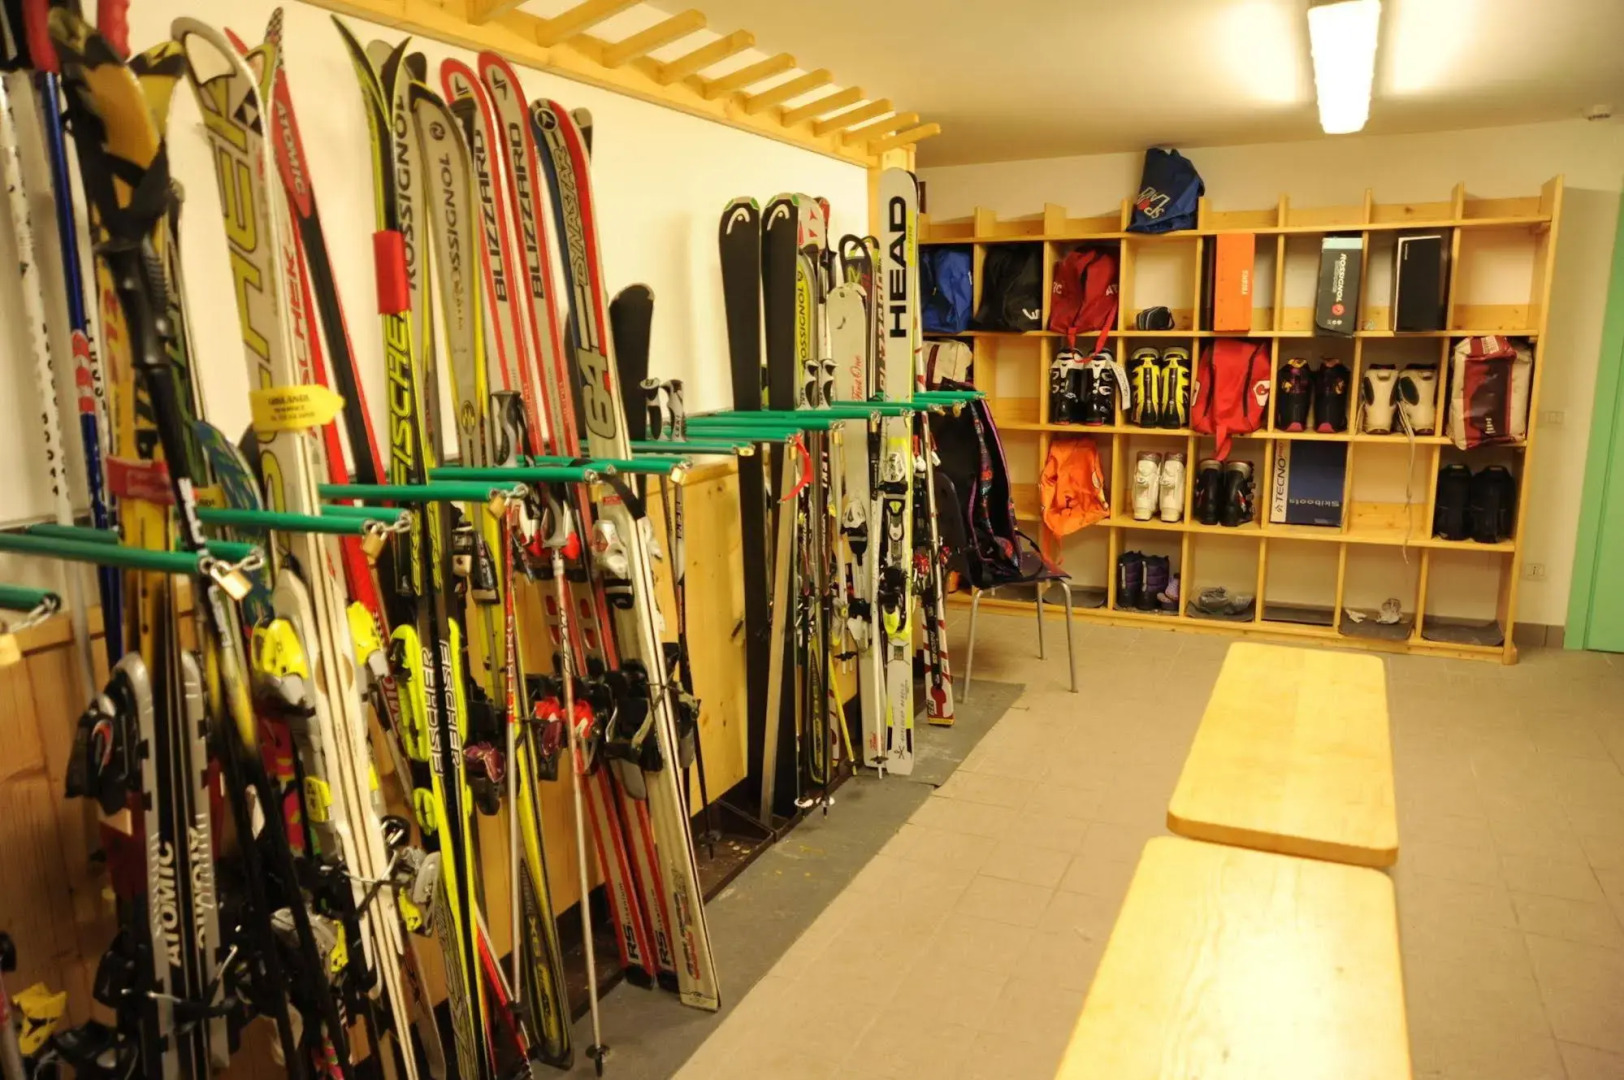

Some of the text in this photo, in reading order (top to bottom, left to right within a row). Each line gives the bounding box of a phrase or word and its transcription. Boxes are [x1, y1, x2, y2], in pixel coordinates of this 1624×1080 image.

[275, 99, 306, 195] ATOMIC
[509, 122, 545, 300] BLIZZARD
[473, 128, 508, 303] BLIZZARD
[553, 145, 589, 287] DYNASTAR
[889, 196, 907, 338] HEAD
[1335, 253, 1347, 302] ROSSIGNOL
[798, 286, 808, 364] OSSIGNOL
[383, 313, 413, 484] FISCHE
[576, 343, 617, 440] 64
[1289, 498, 1340, 508] Skiboots
[425, 647, 444, 777] FISCHER
[439, 640, 461, 770] FISCHER
[157, 840, 182, 968] ATOMIC
[623, 923, 639, 960] RS
[655, 929, 671, 966] RS
